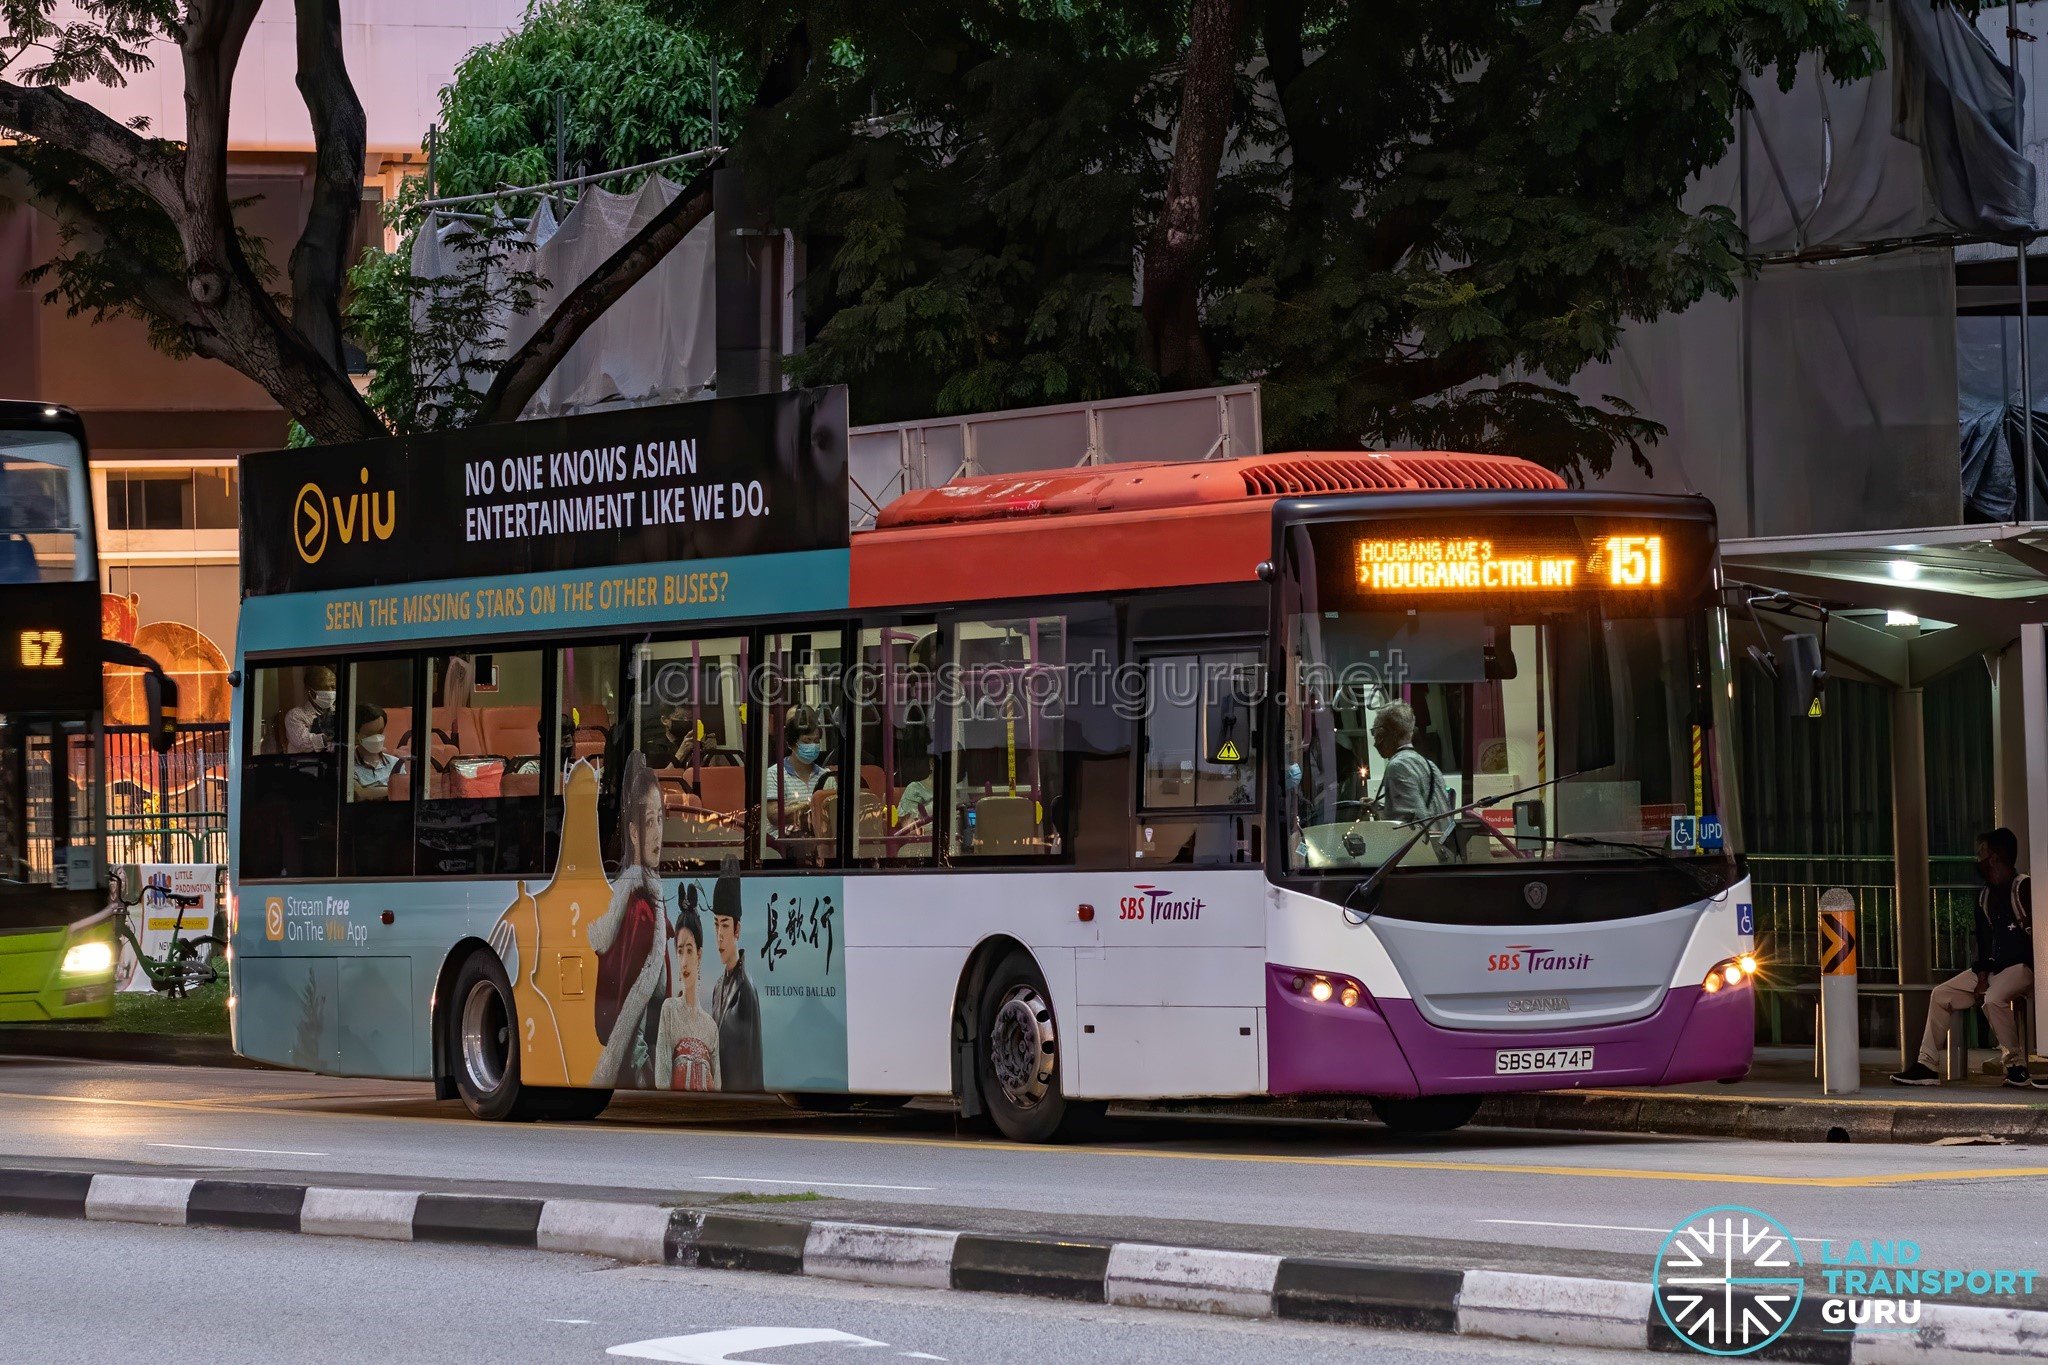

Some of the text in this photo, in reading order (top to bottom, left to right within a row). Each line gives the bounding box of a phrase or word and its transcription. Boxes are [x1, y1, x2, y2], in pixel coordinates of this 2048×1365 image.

[465, 438, 697, 497] NO ONE KNOWS ASIAN
[333, 467, 396, 544] viu
[465, 480, 770, 542] ENTERTAINMENT LIKE WE DO.
[1361, 541, 1492, 562] HOUGANG AVE 3
[1605, 537, 1661, 585] 151
[1373, 559, 1576, 588] HOUGANG CTRL INT
[325, 571, 729, 631] SEEN THE MISSING STARS ON THE OTHER BUSES?
[20, 631, 63, 666] 62
[1700, 823, 1722, 840] UPD
[174, 870, 193, 880] LITTLE
[175, 883, 211, 893] PADDINGTON
[287, 896, 350, 916] Stream Free
[1119, 890, 1207, 924] SBS Transit
[288, 921, 303, 940] On
[305, 920, 324, 940] The
[347, 921, 368, 947] App
[1487, 949, 1594, 974] SBS Transit
[765, 985, 836, 997] THE LONG BALLAD
[1507, 997, 1571, 1013] SCANIA
[1498, 1050, 1593, 1072] SBS8474P
